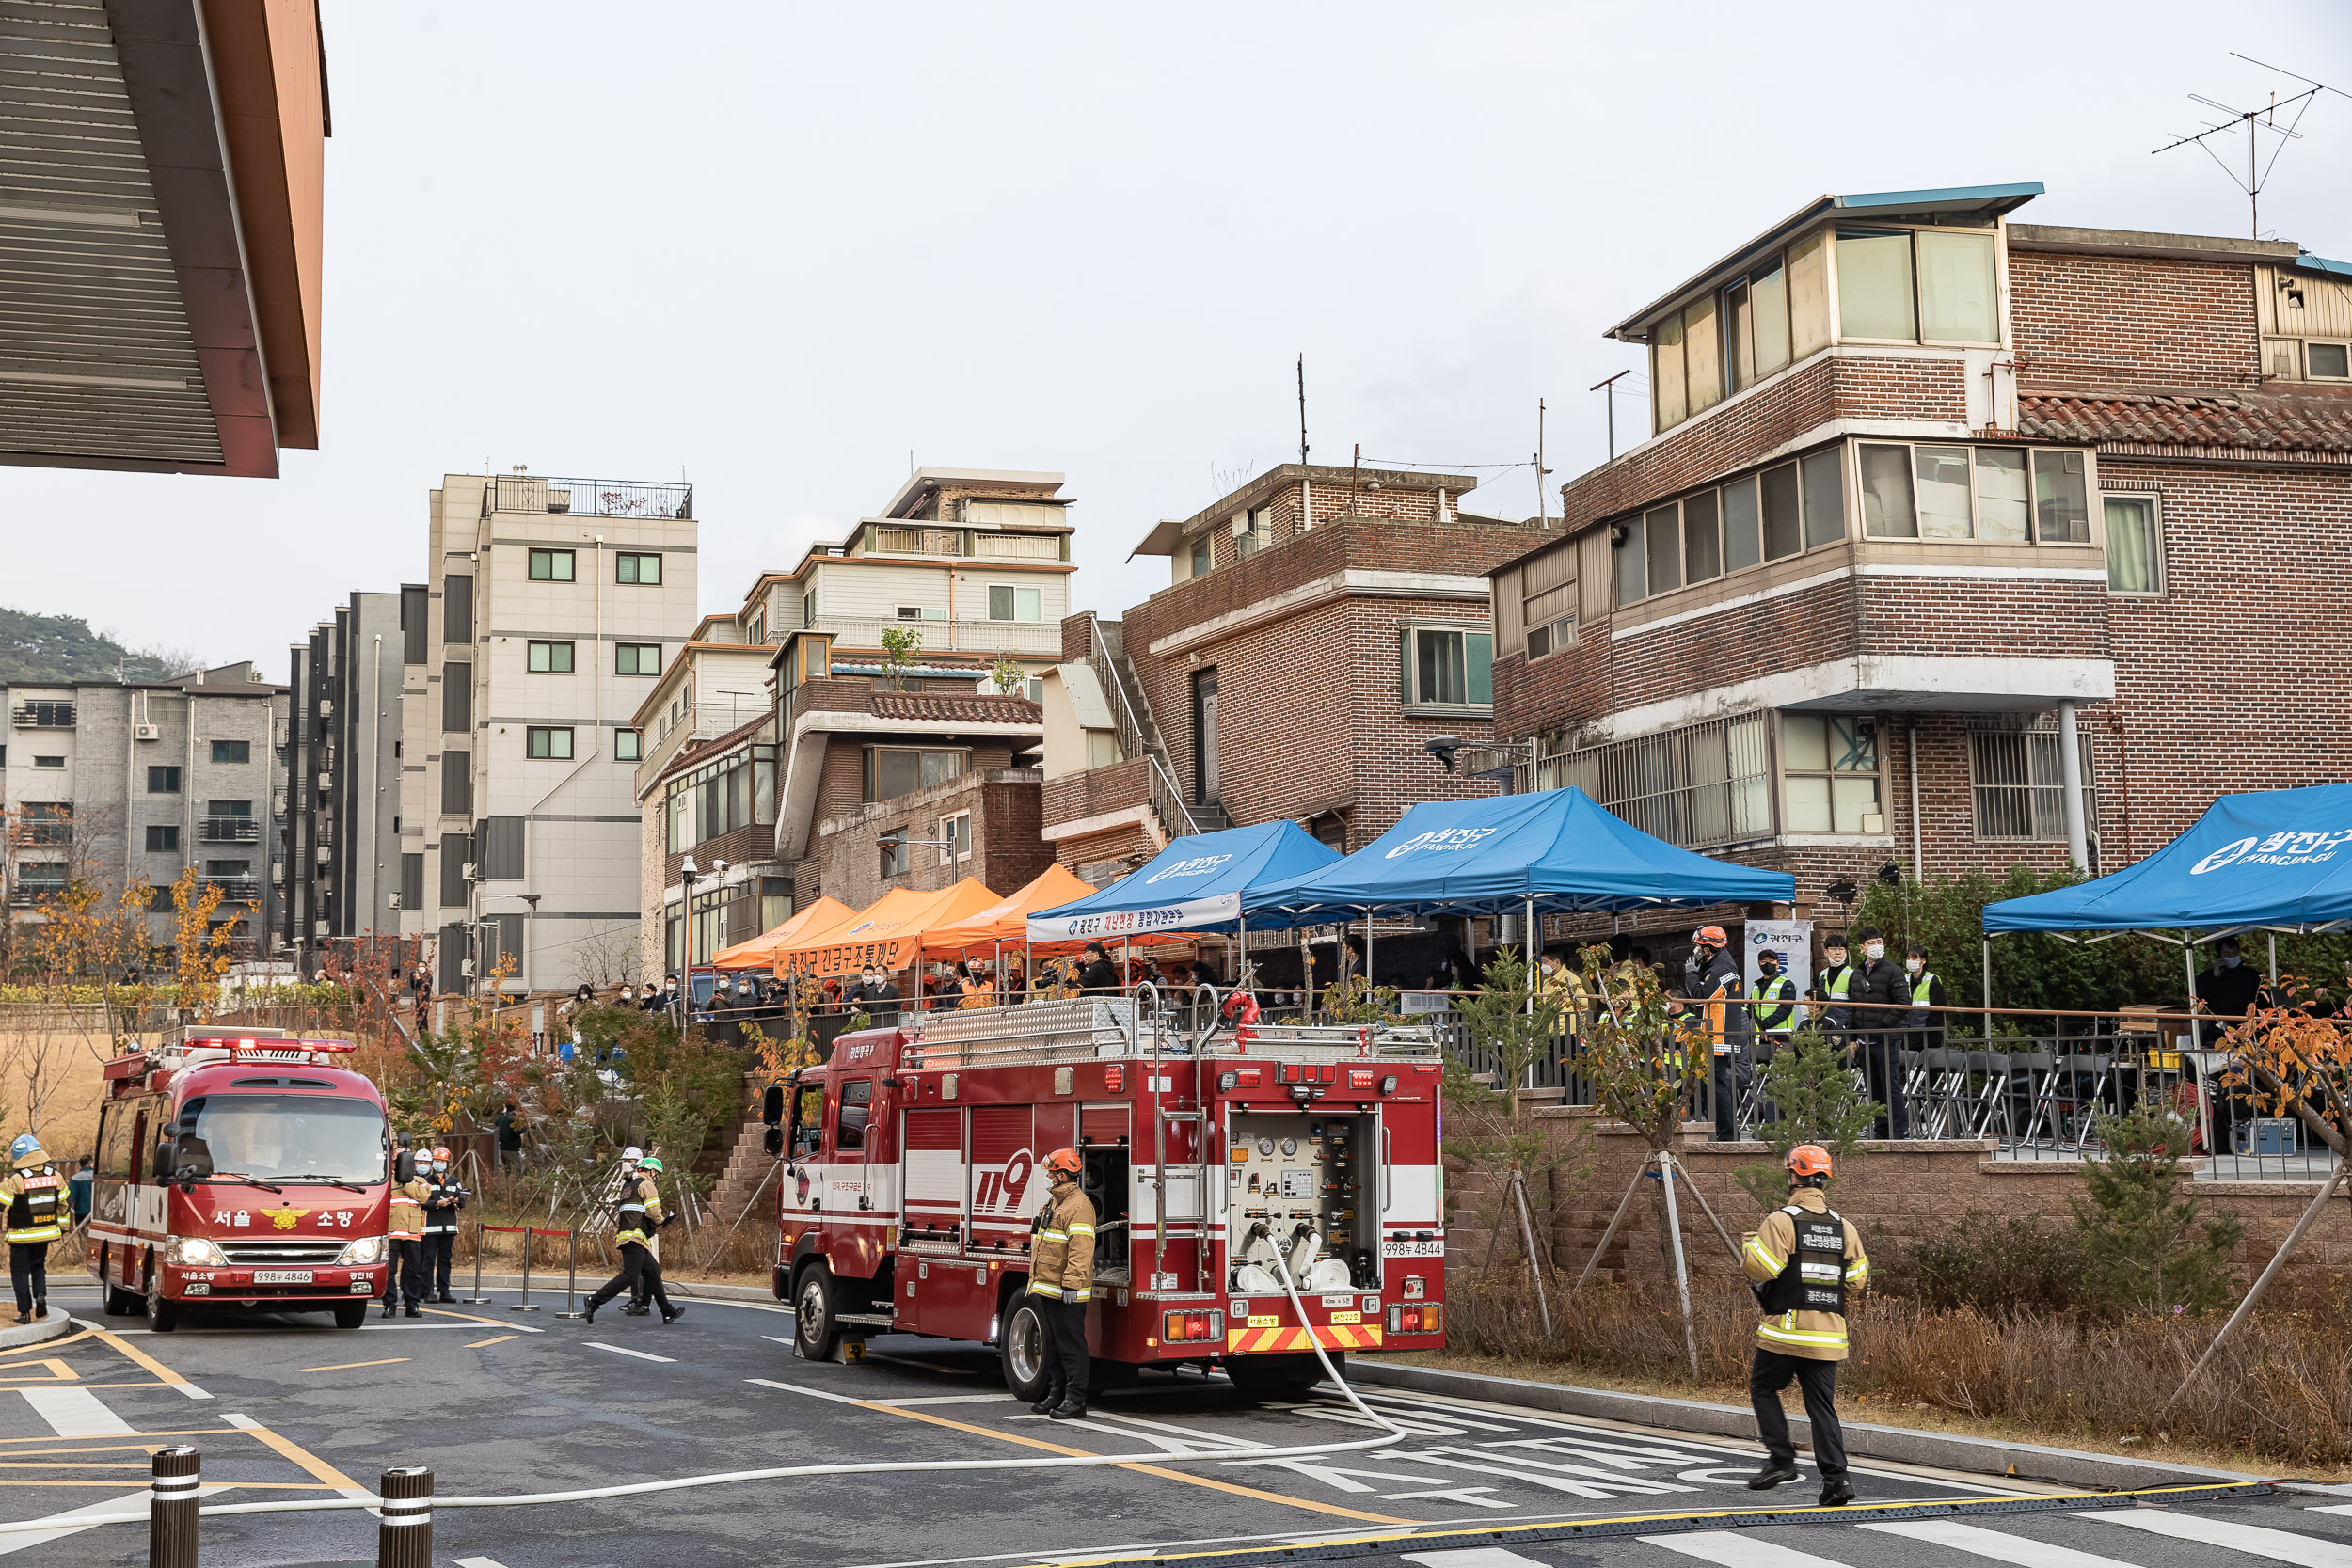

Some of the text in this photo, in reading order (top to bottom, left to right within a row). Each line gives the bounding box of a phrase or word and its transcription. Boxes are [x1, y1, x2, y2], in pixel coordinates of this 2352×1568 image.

[1429, 827, 1498, 843] 광진구
[2257, 829, 2352, 853] 광진구
[1183, 853, 1233, 871] 광진구
[2236, 850, 2338, 866] GWANGJIN-GU
[1079, 908, 1184, 934] 광진구 재난현장 통합지원본부
[1769, 933, 1804, 943] 광진구
[789, 941, 899, 975] 광진구 긴급구조통제단
[973, 1150, 1032, 1214] 119
[214, 1209, 354, 1227] 서울 소방
[1385, 1243, 1442, 1256] 998누 4844
[181, 1272, 215, 1281] 서울소방
[258, 1272, 310, 1282] 998누 4846
[1248, 1317, 1277, 1326] 서울소방
[1333, 1313, 1359, 1323] 광진22호
